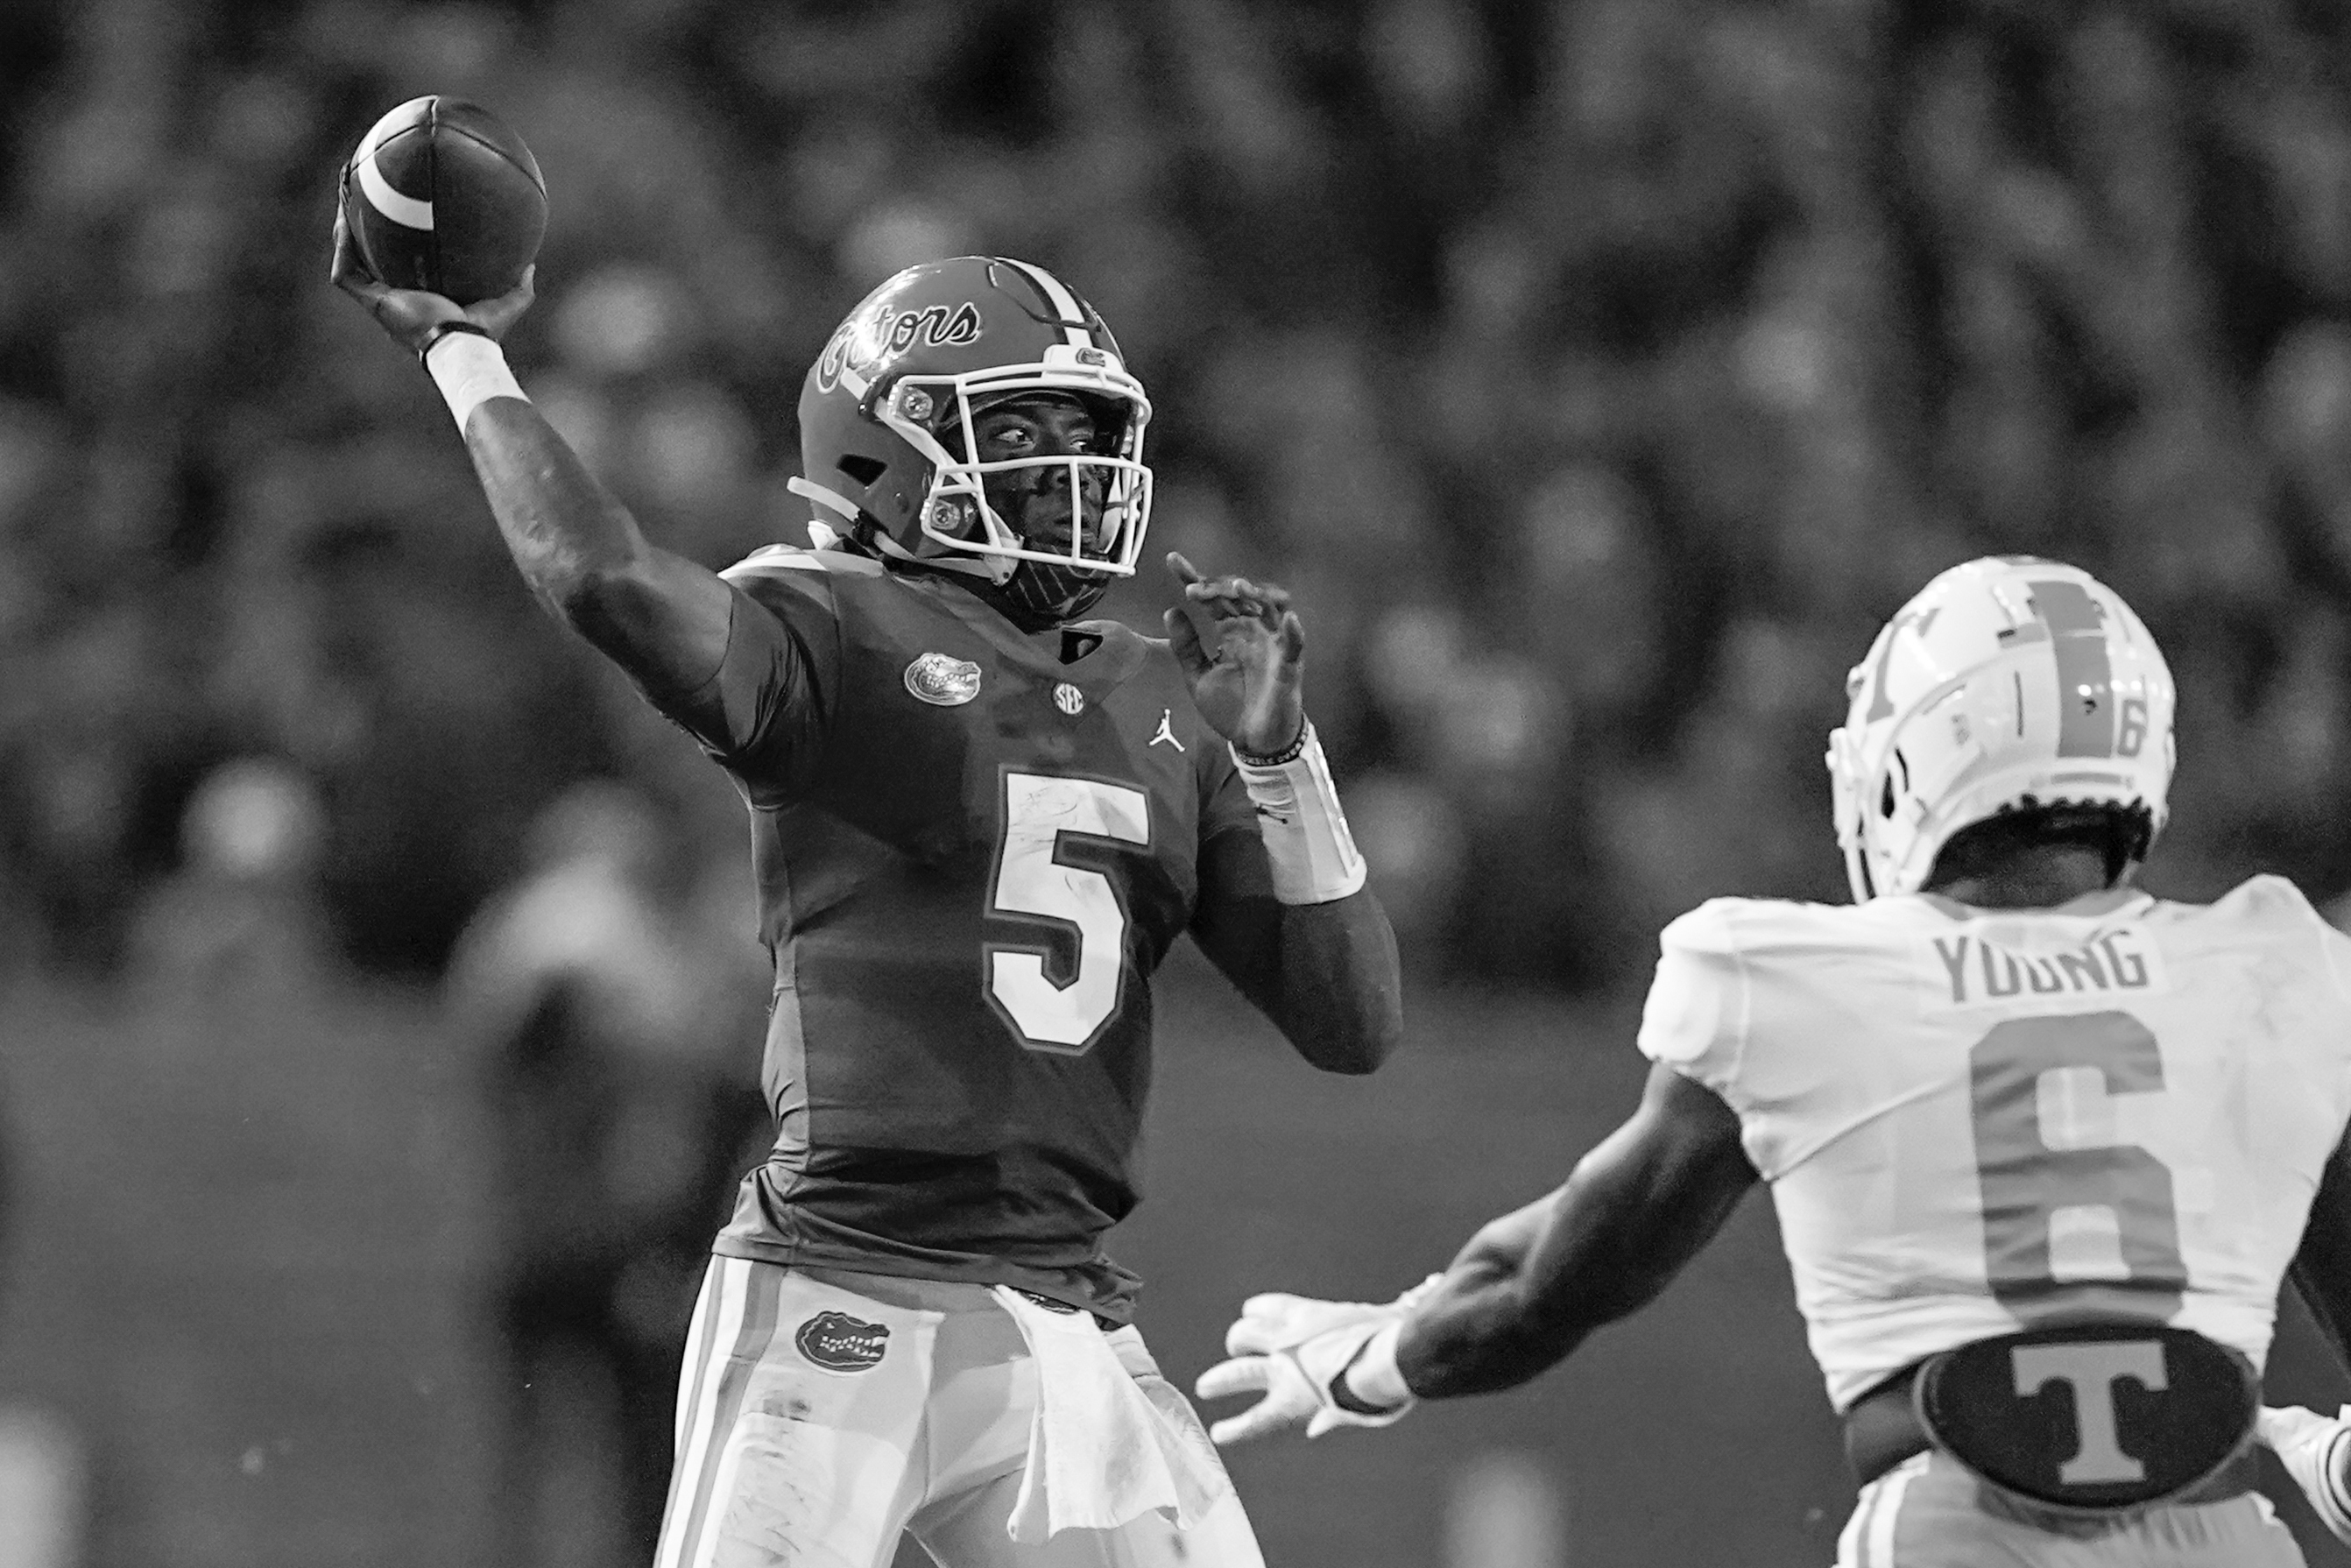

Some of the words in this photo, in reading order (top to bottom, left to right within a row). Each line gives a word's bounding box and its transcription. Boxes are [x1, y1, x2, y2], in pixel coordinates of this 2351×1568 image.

[1054, 682, 1084, 715] SEC
[2118, 699, 2148, 758] 6
[983, 764, 1153, 1055] 5
[1932, 929, 2149, 1004] YOUNG
[1969, 1009, 2188, 1324] 6
[2011, 1339, 2170, 1486] T
